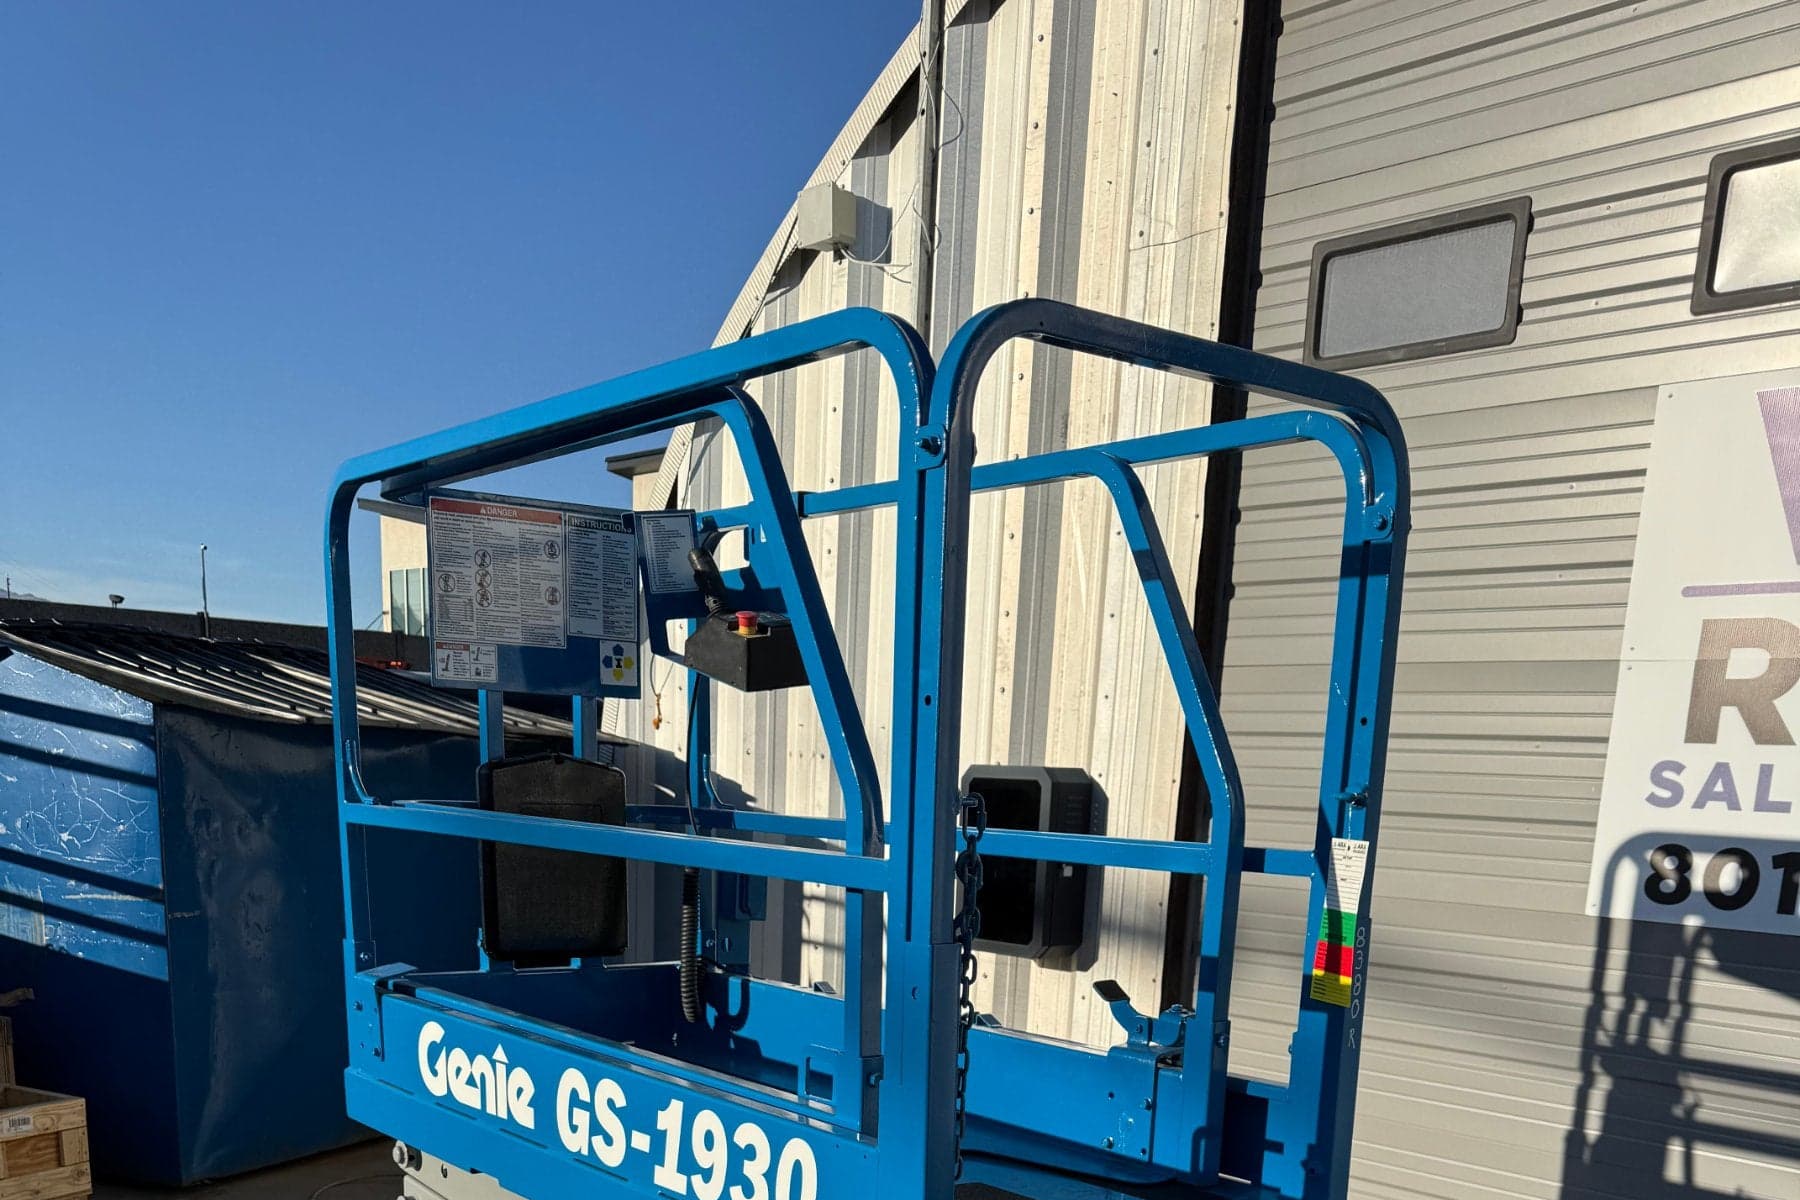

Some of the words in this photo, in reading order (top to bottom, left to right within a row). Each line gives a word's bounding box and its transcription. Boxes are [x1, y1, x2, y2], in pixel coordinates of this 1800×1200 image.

[487, 505, 518, 518] DANGER
[1684, 617, 1800, 745] R
[1644, 760, 1793, 814] SAL
[1644, 843, 1800, 916] 801
[418, 1021, 535, 1129] Genie
